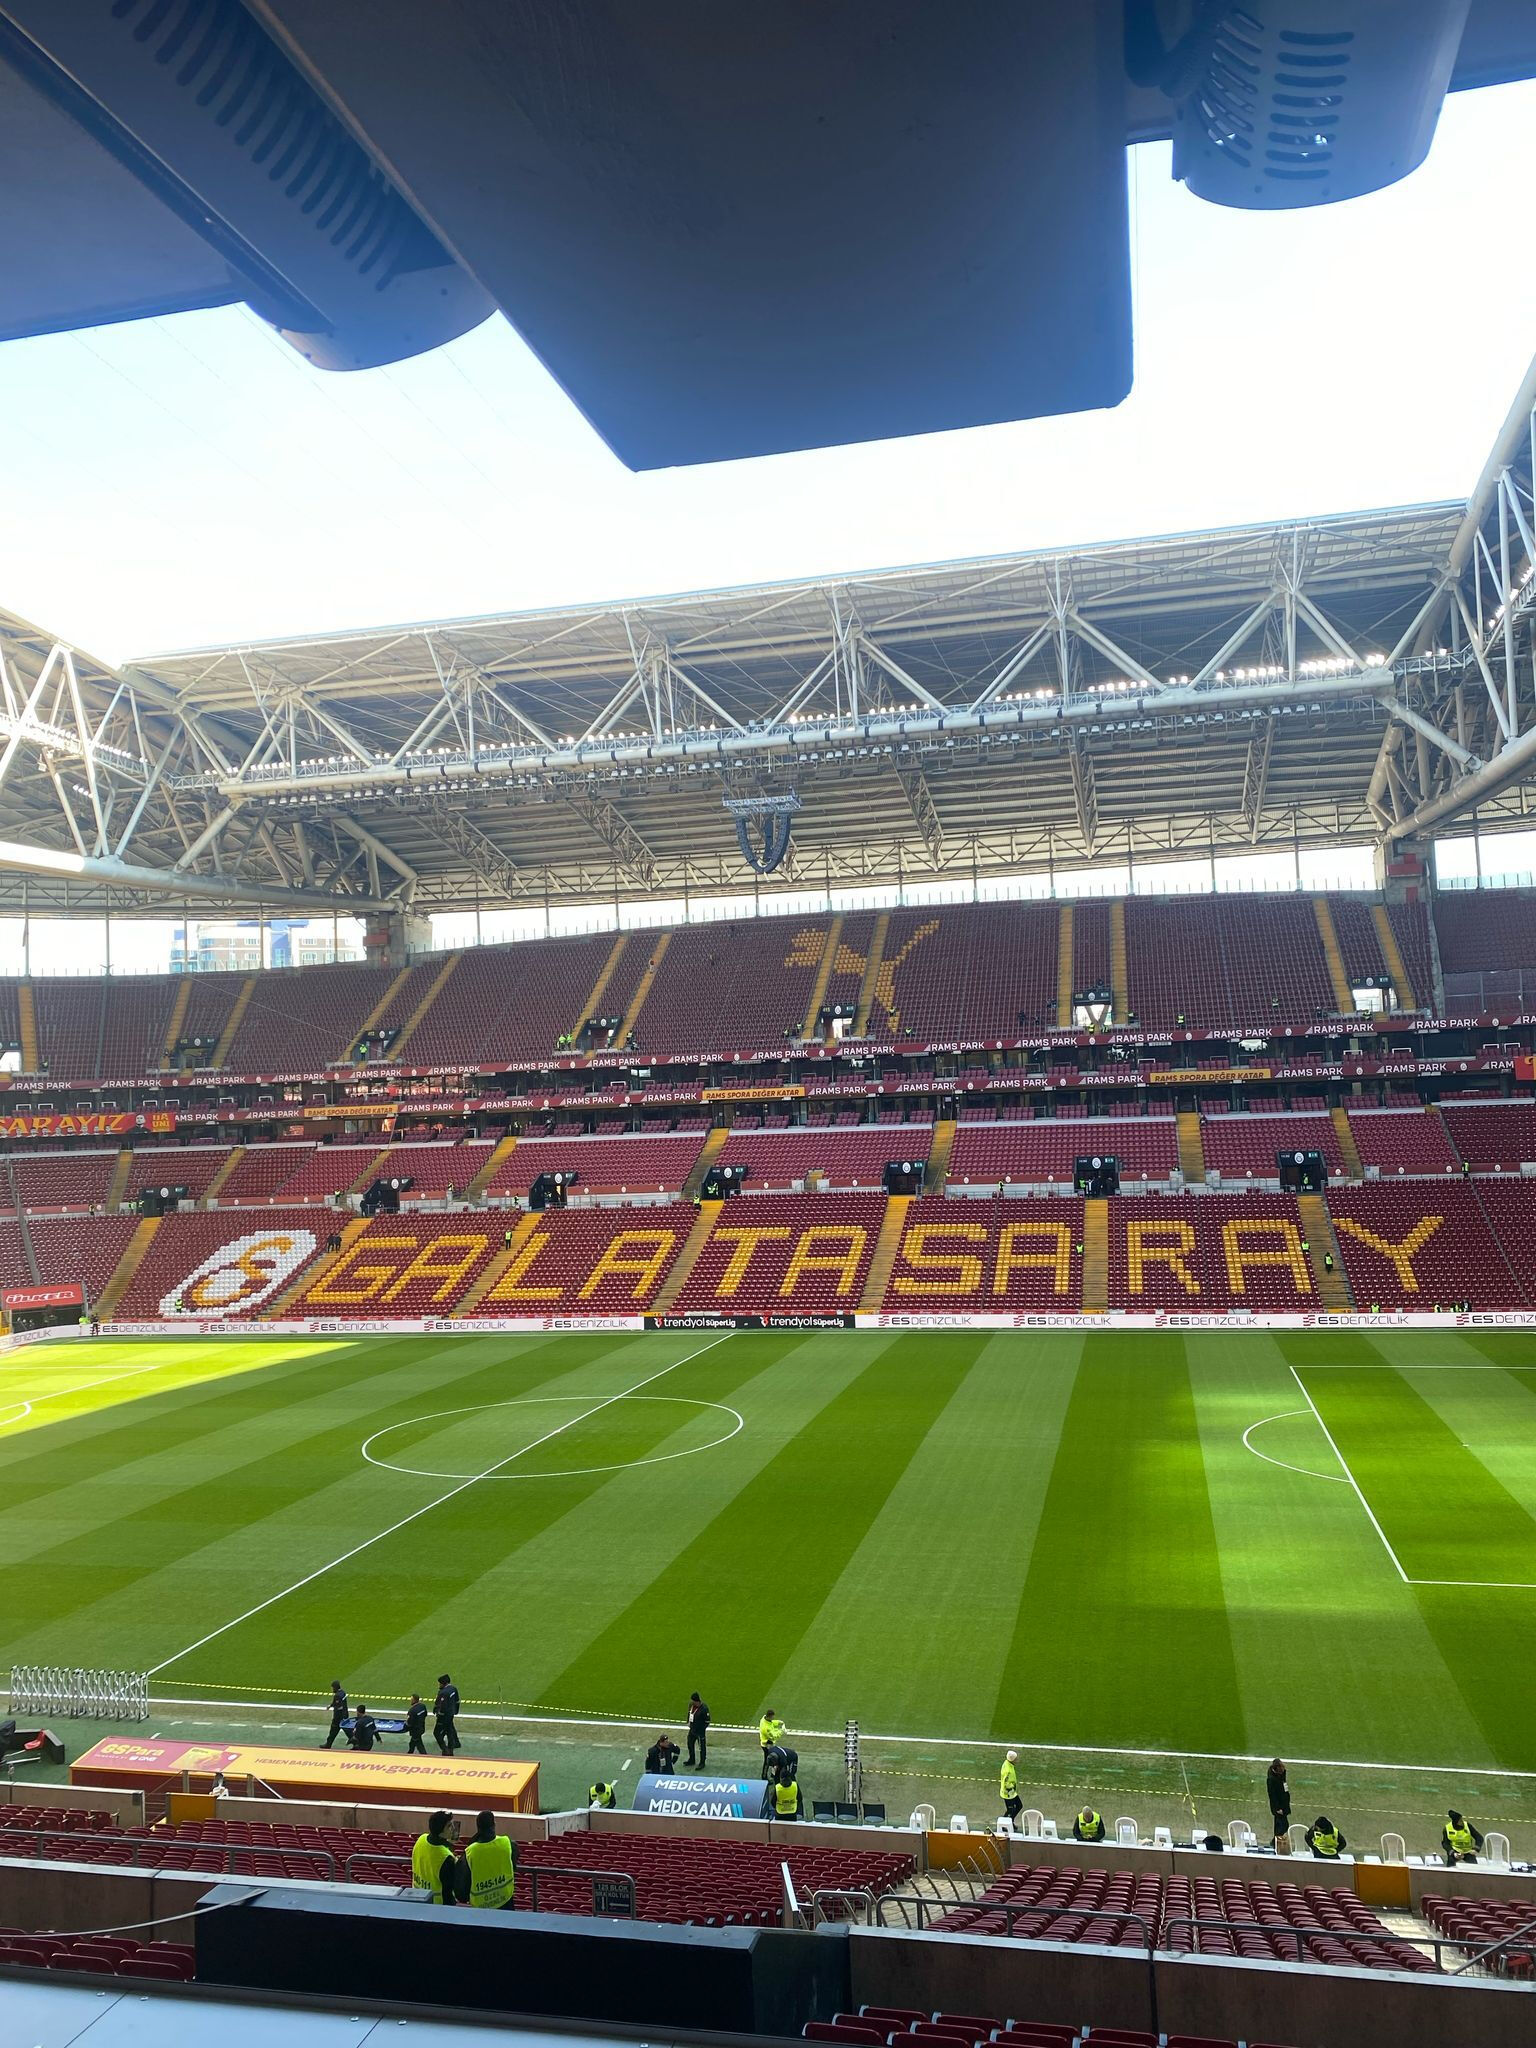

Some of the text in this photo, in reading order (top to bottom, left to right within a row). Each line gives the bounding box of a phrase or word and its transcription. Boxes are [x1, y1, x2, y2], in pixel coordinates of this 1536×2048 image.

[1417, 1019, 1478, 1028] RAMS PARK
[1522, 1016, 1536, 1024] RA
[1214, 1028, 1272, 1038] RAMS PARK
[1347, 1024, 1373, 1032] PARK
[1386, 1065, 1415, 1073] RAMS
[1490, 1061, 1514, 1069] RAM
[17, 1082, 43, 1090] RAMS
[109, 1079, 161, 1088] RAMS PARK
[306, 1216, 1444, 1302] GALATASARAY
[664, 1318, 705, 1328] trendyol
[770, 1317, 812, 1327] trendyol
[101, 1744, 165, 1756] GSPara
[340, 1761, 517, 1780] www.gspara.com.tr
[655, 1779, 737, 1793] MEDICANA
[648, 1799, 732, 1817] MEDICANA
